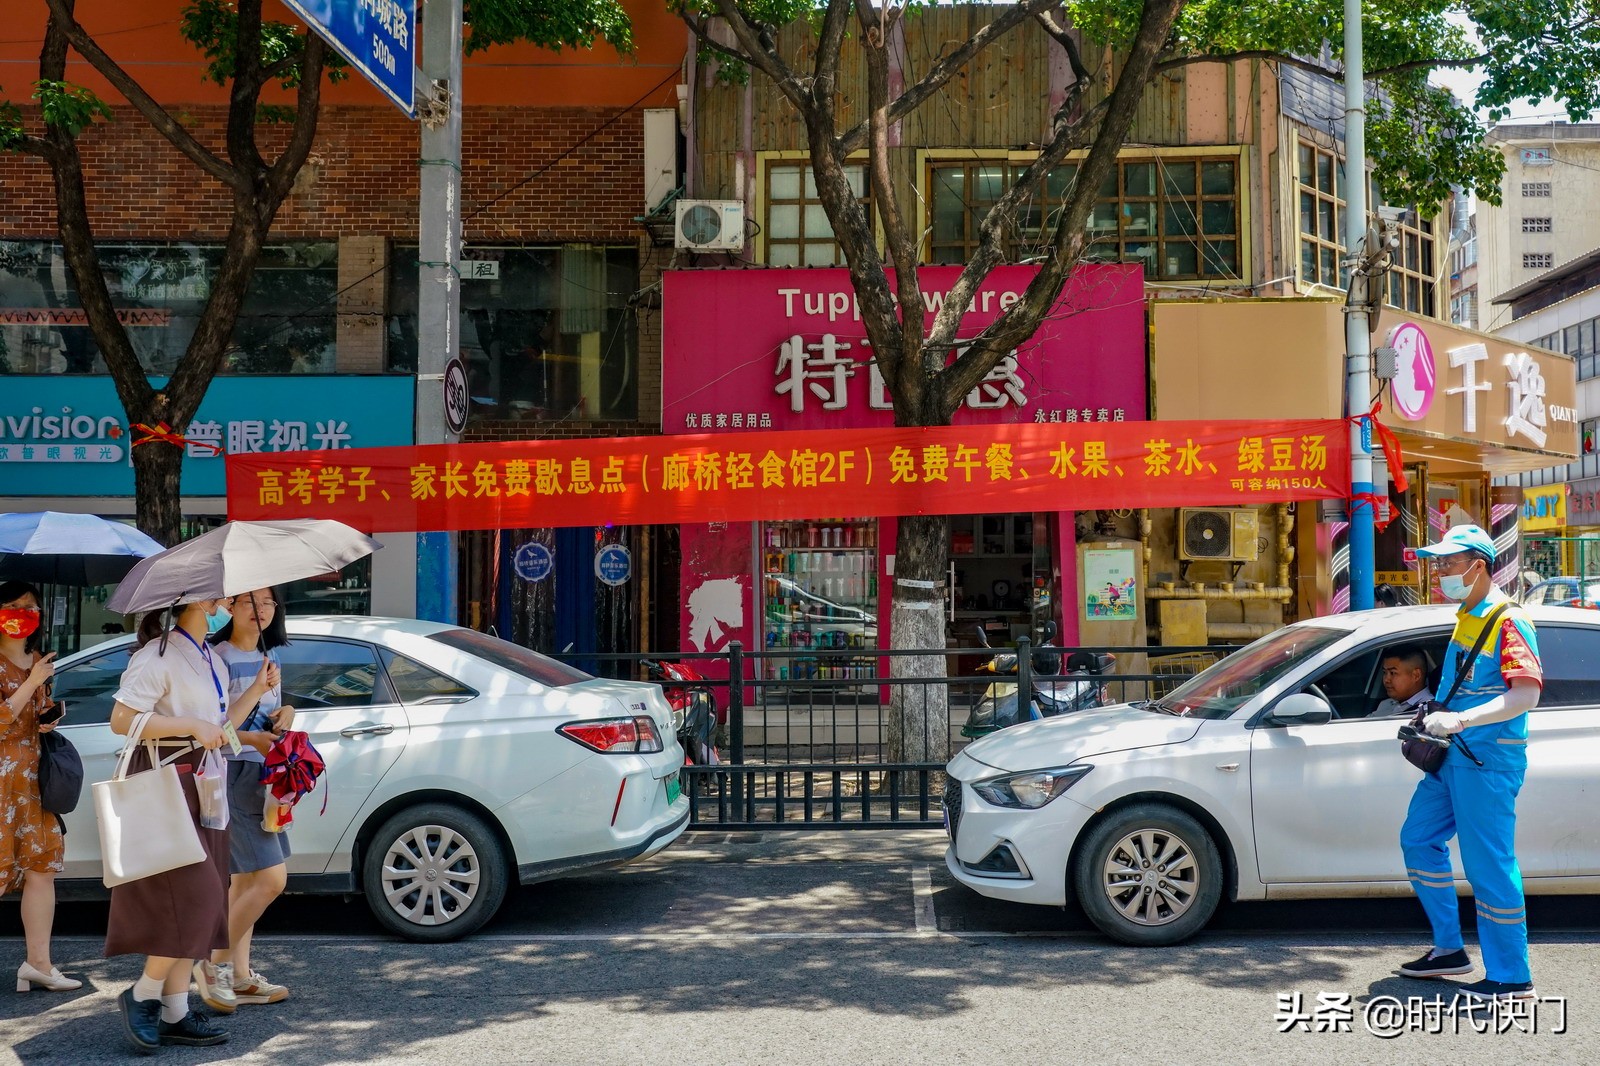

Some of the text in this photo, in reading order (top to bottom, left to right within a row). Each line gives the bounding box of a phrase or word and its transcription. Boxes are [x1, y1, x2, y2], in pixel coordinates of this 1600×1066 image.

[360, 0, 408, 51] 城路
[372, 33, 396, 76] 500m
[474, 262, 495, 278] 租
[778, 288, 1020, 322] Tupware
[685, 412, 772, 429] 优质家居用品
[1034, 407, 1126, 424] 永红路专卖店
[1549, 404, 1571, 421] QIAN
[0, 406, 121, 439] vision
[1230, 476, 1327, 492] 可容纳150人
